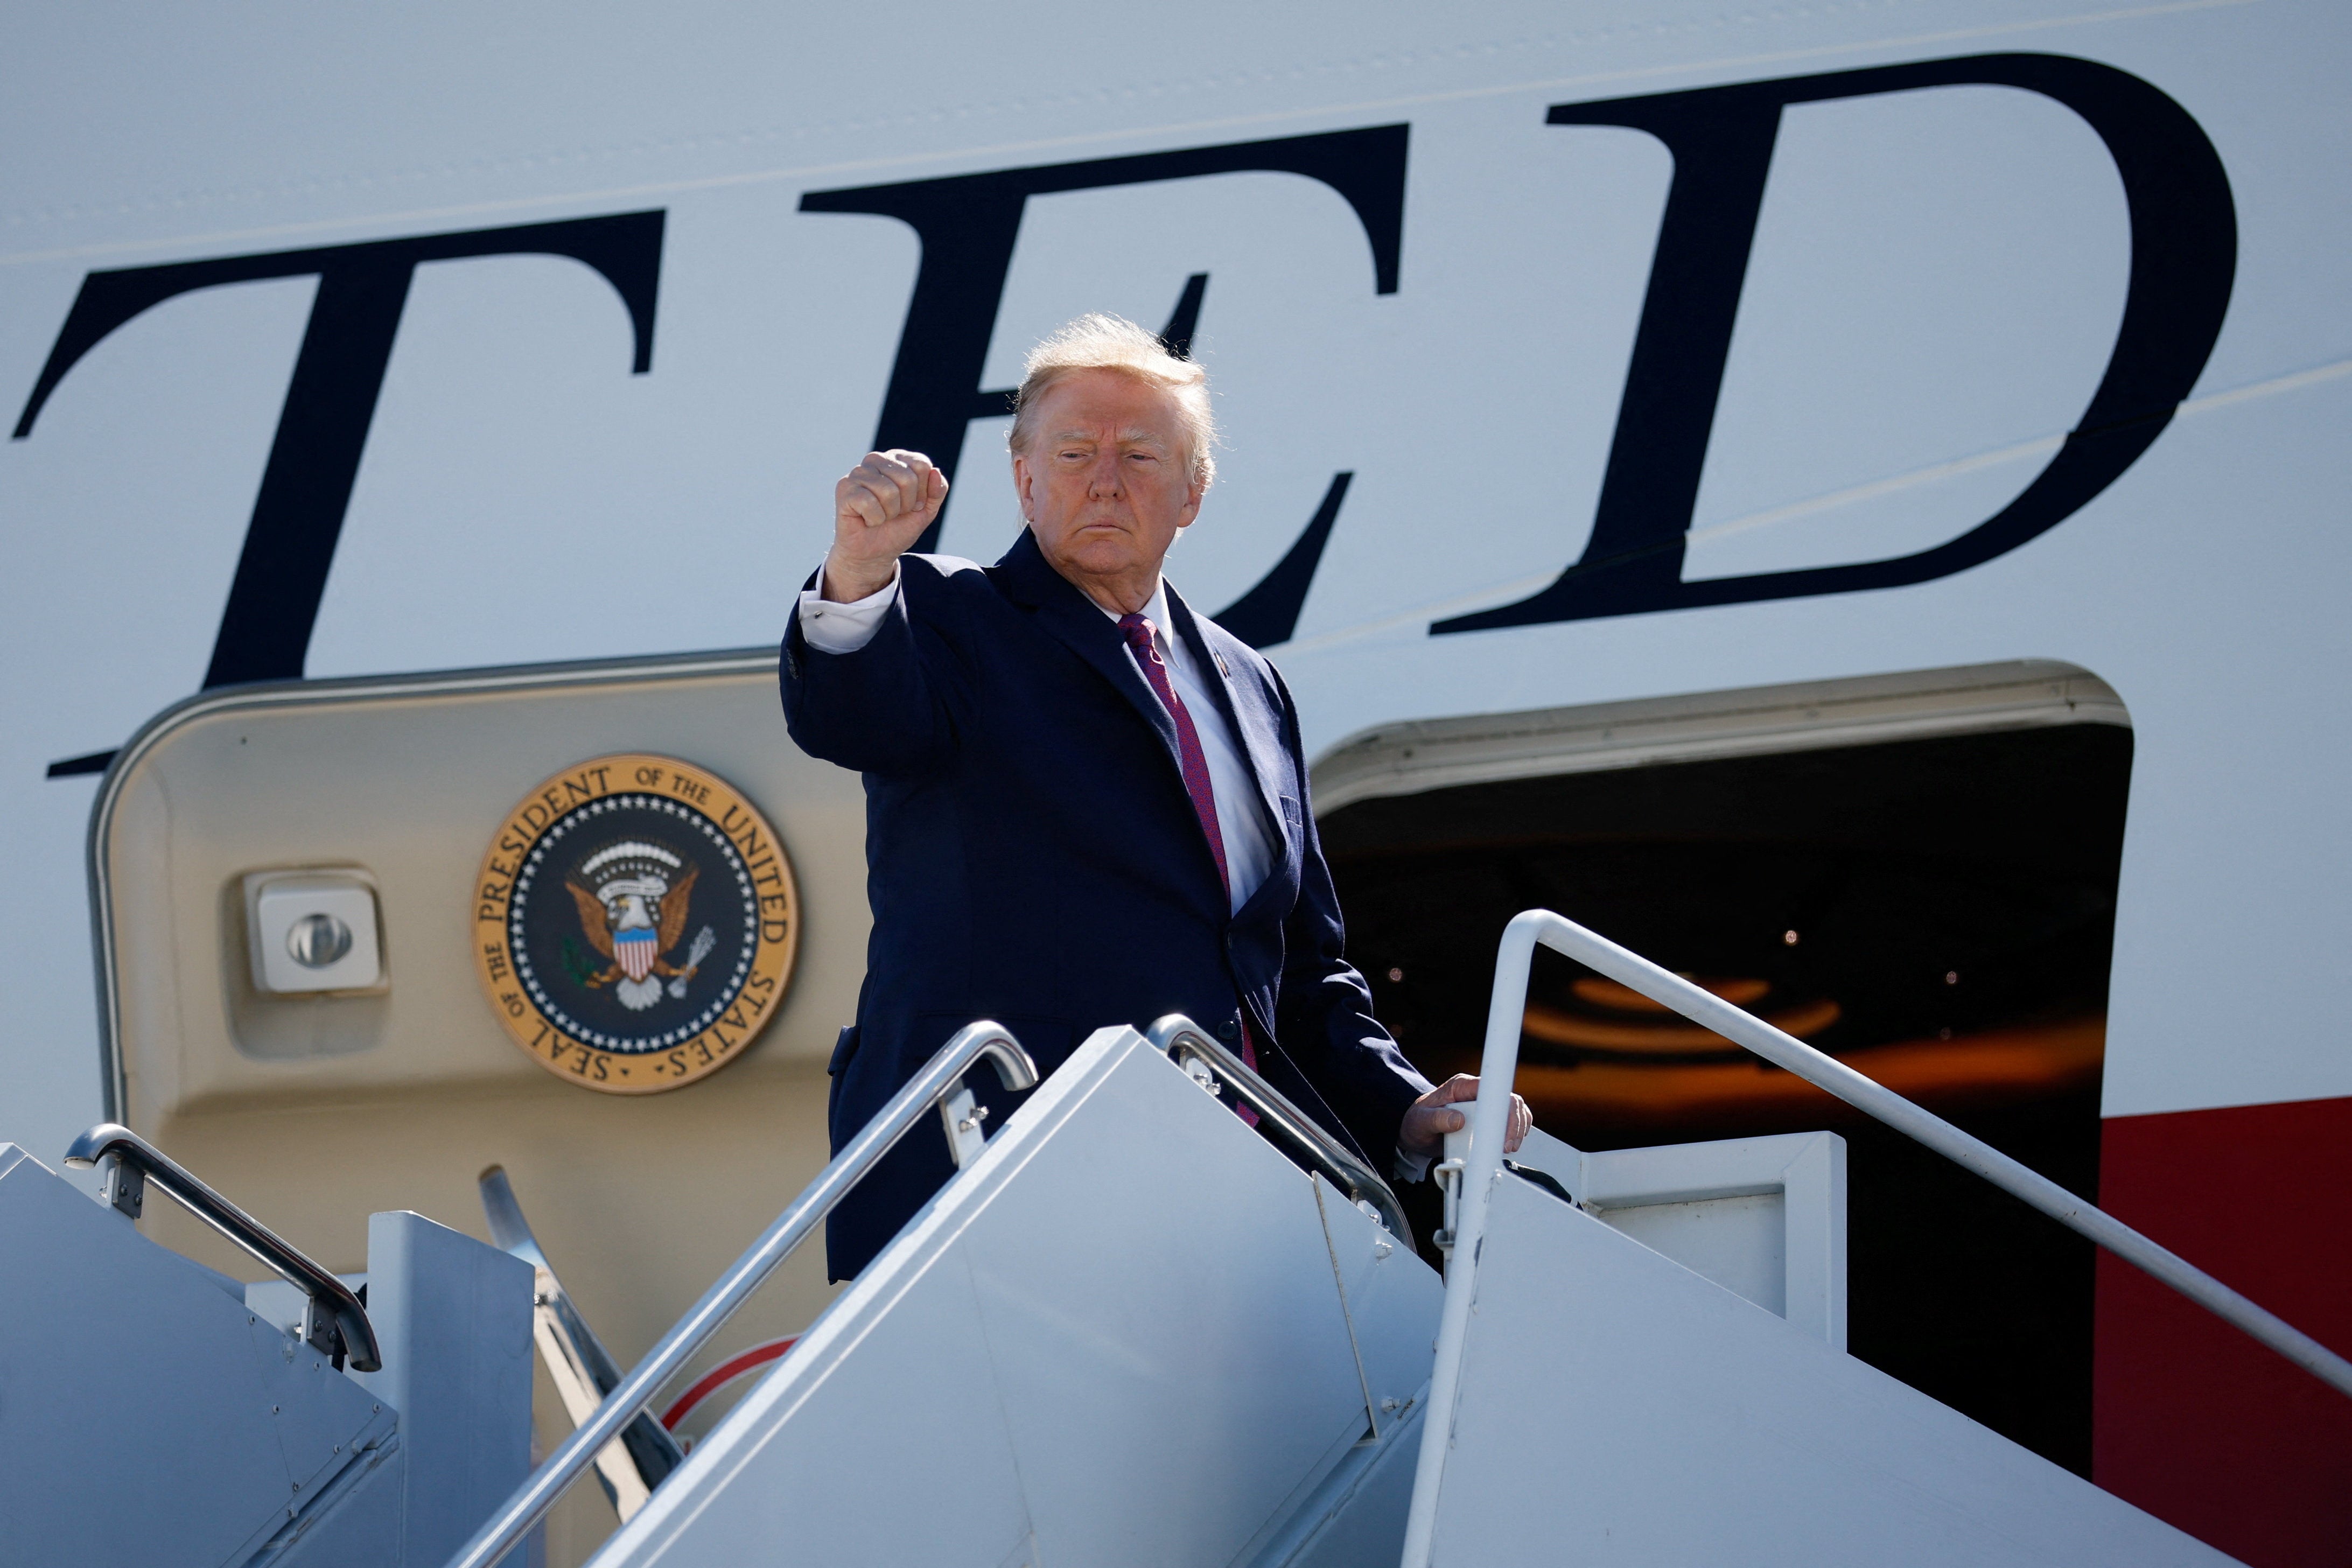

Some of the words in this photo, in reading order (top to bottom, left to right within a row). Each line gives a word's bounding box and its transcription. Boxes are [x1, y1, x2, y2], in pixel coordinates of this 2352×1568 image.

[11, 52, 2238, 778] TED
[635, 767, 663, 786] OF
[673, 774, 711, 806] THE
[479, 765, 610, 922] PRESIDENT
[723, 805, 788, 943] UNITED
[485, 941, 507, 983] THE
[501, 993, 525, 1017] OF
[668, 971, 774, 1076] STATES
[531, 1019, 612, 1080] SEAL
